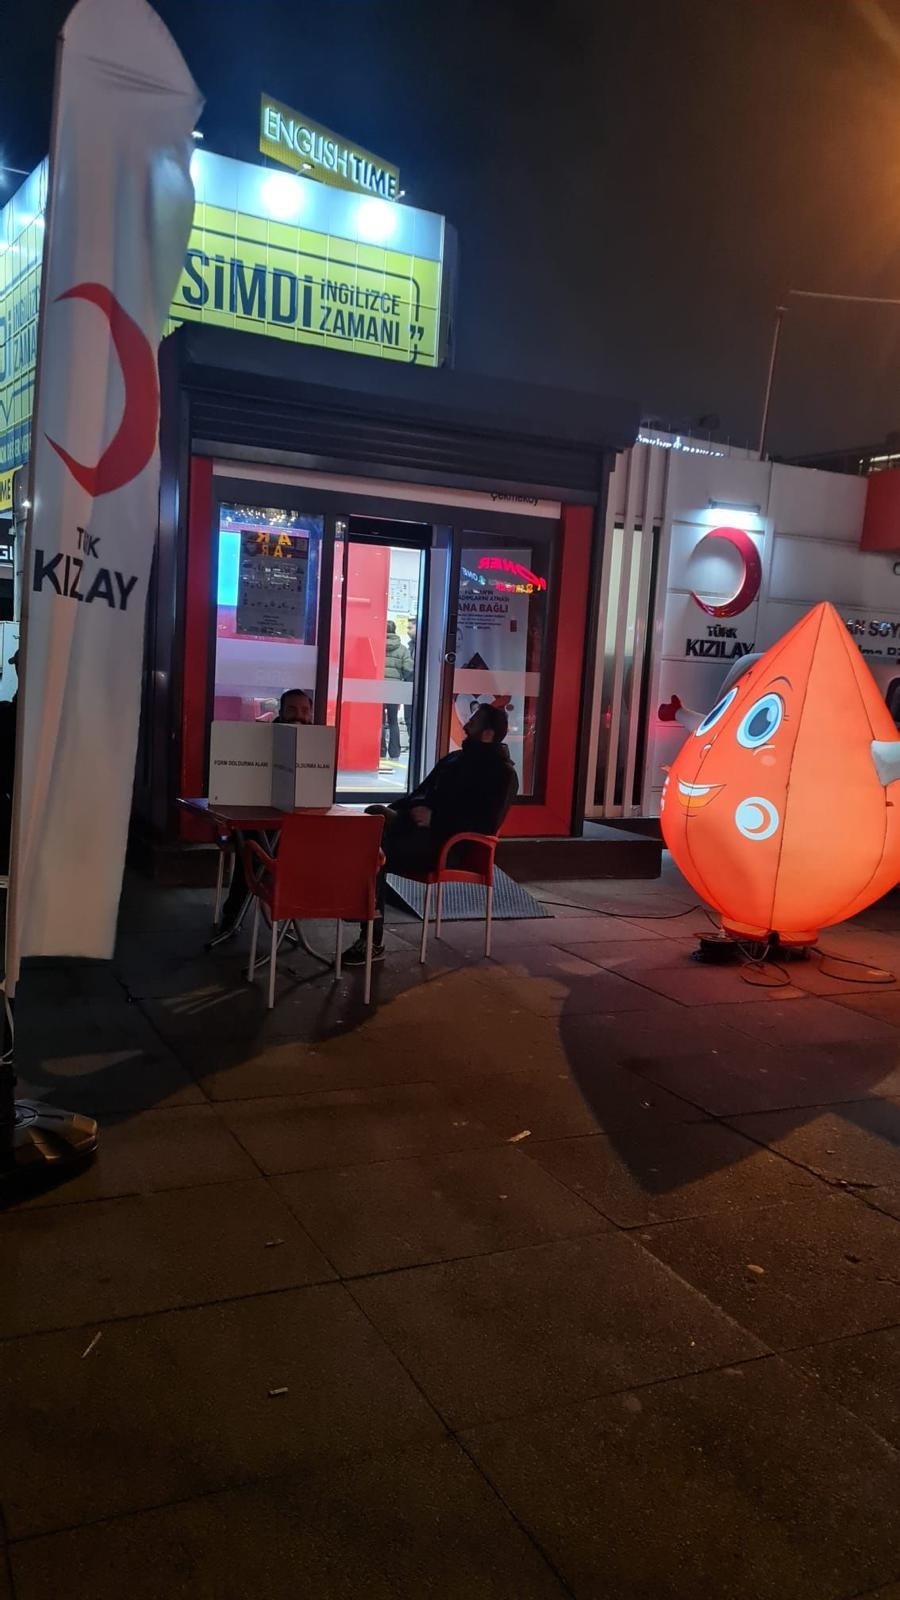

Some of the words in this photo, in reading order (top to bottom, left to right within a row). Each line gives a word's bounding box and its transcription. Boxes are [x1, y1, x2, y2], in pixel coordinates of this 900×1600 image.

[33, 549, 138, 611] KIZAY
[479, 602, 509, 613] BAĞLI
[686, 637, 755, 659] KIZILAY
